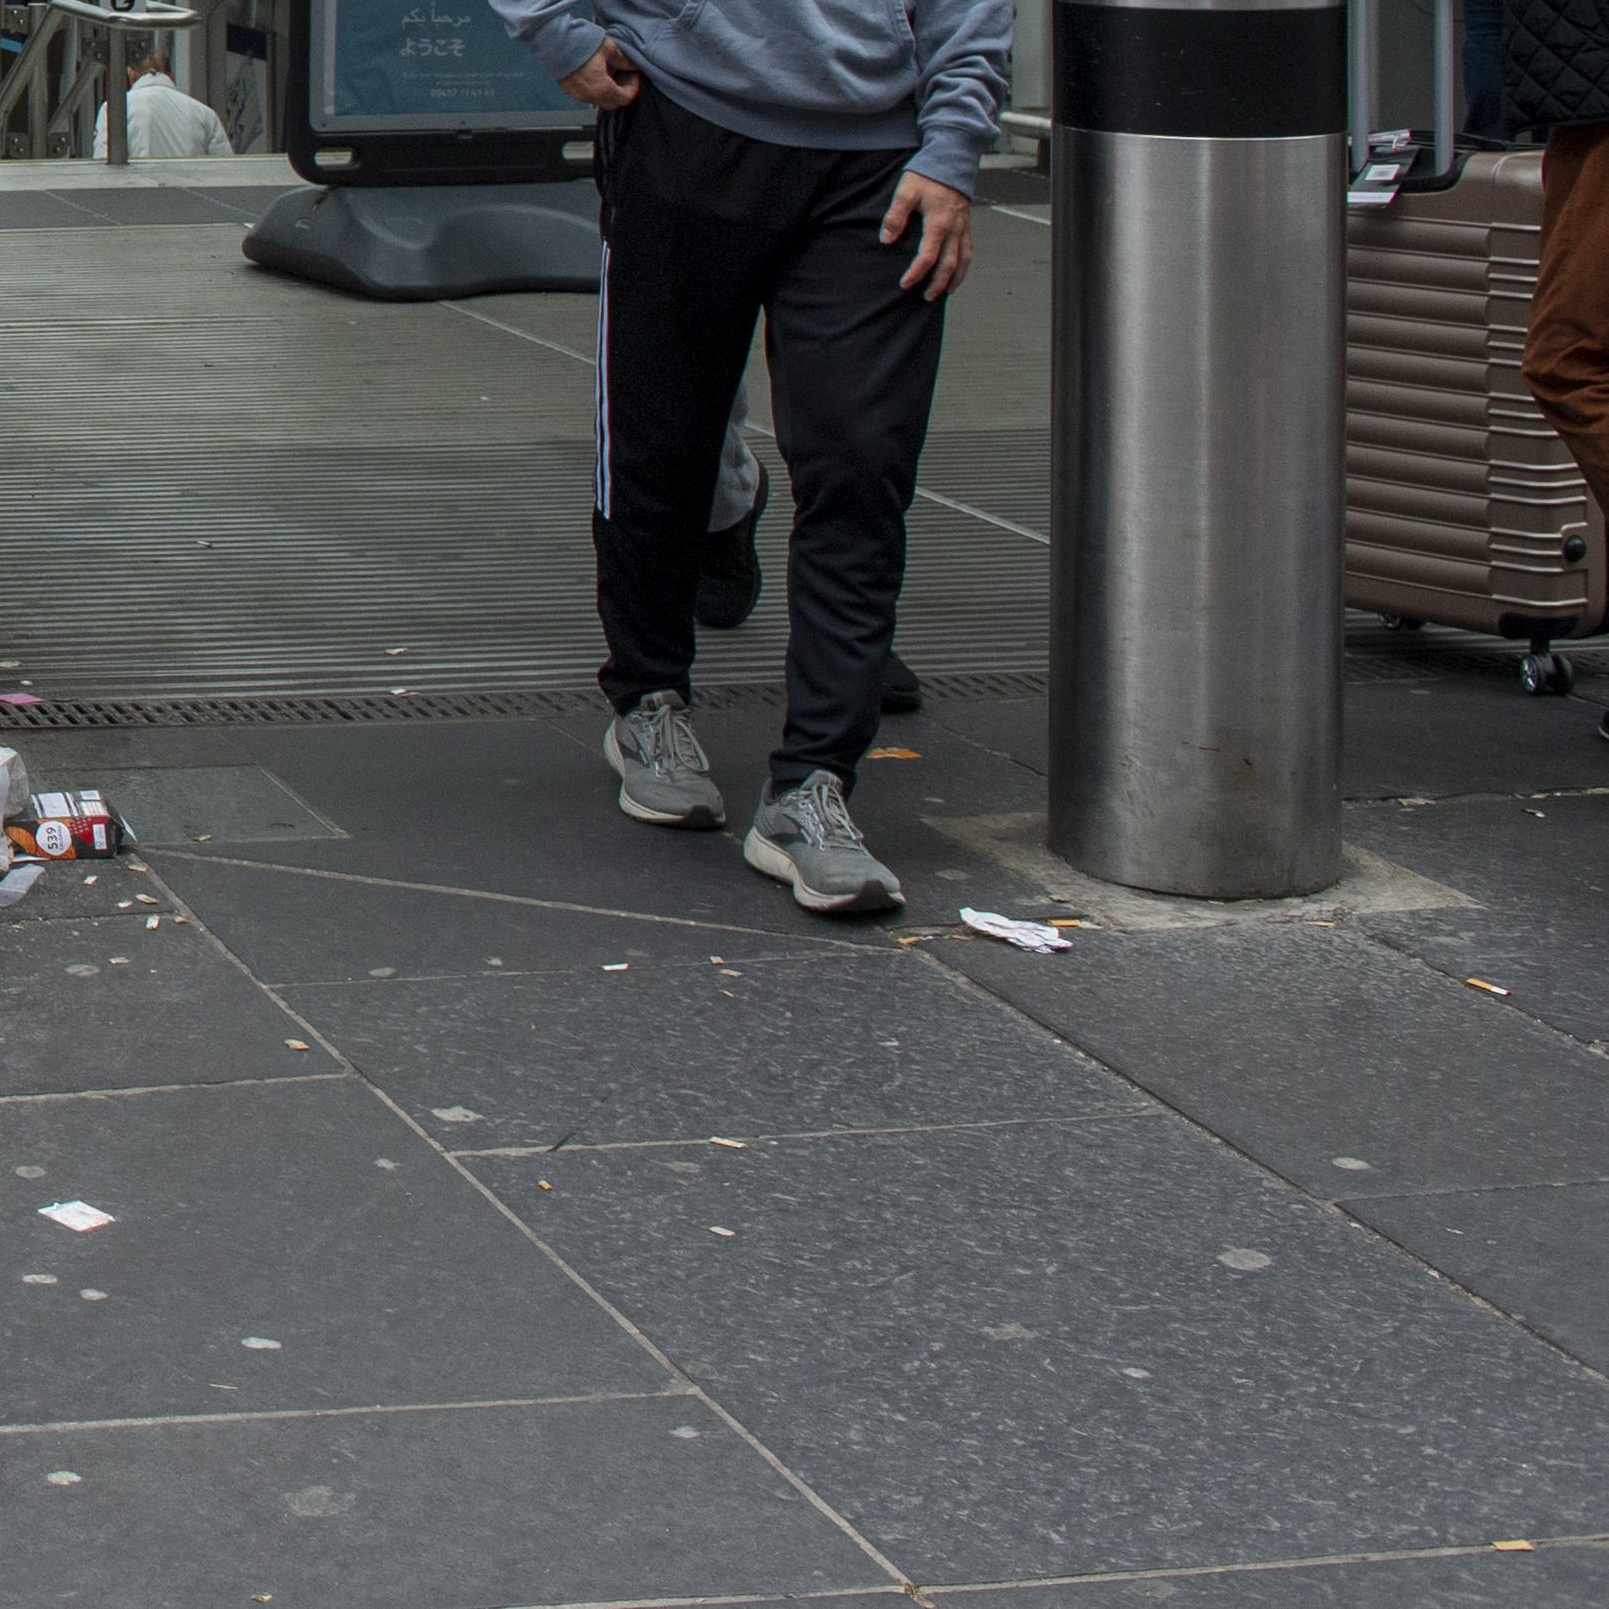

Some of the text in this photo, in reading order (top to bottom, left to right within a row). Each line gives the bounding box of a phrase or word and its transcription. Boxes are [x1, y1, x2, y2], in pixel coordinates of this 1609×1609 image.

[399, 37, 466, 58] ようこそ
[46, 826, 58, 851] 539
